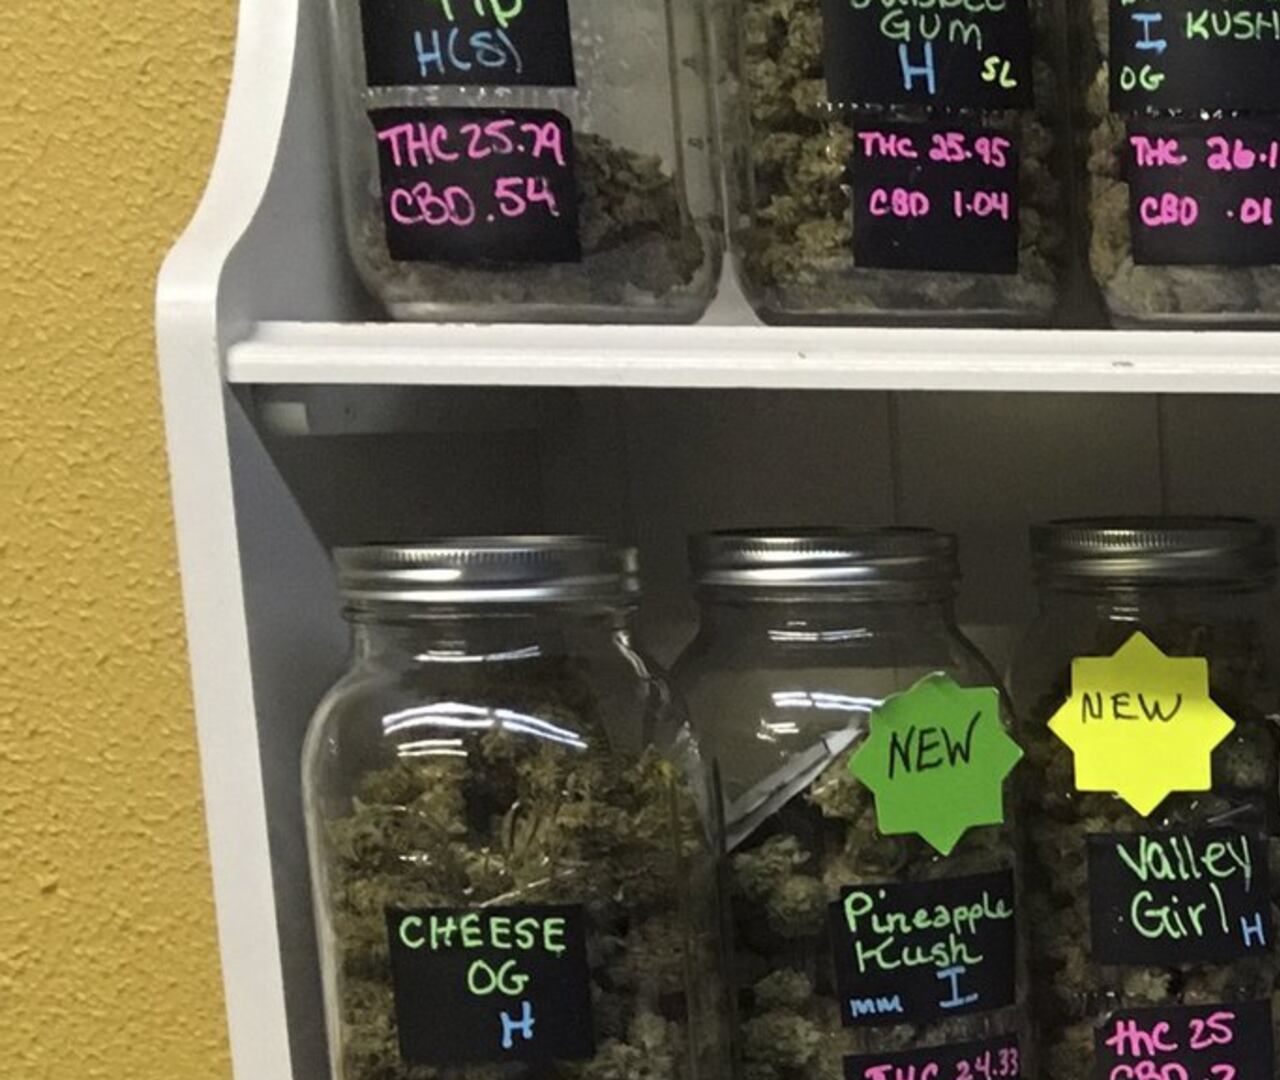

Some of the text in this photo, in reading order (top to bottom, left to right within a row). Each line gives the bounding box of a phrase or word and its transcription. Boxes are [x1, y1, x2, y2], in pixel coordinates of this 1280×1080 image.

[880, 8, 982, 51] GUM
[1186, 9, 1280, 40] KUSH
[899, 41, 1017, 94] H SL
[1120, 64, 1165, 91] OG
[378, 127, 448, 167] THC
[859, 132, 1011, 168] THC 25.95
[1130, 136, 1188, 167] THC
[390, 177, 559, 225] CBD .54
[870, 190, 1009, 219] CBD 1.04
[1140, 193, 1274, 227] CBD .01
[1080, 691, 1182, 725] NEW
[888, 710, 983, 781] NEW
[1116, 835, 1252, 892] Valley
[843, 889, 1013, 935] Pineapple
[1130, 882, 1266, 947] Girl H
[399, 913, 567, 957] CHEESE
[855, 932, 983, 975] Kush
[466, 959, 529, 996] OG
[936, 966, 979, 1009] I
[500, 1001, 536, 1049] H
[1188, 1011, 1236, 1051] 25
